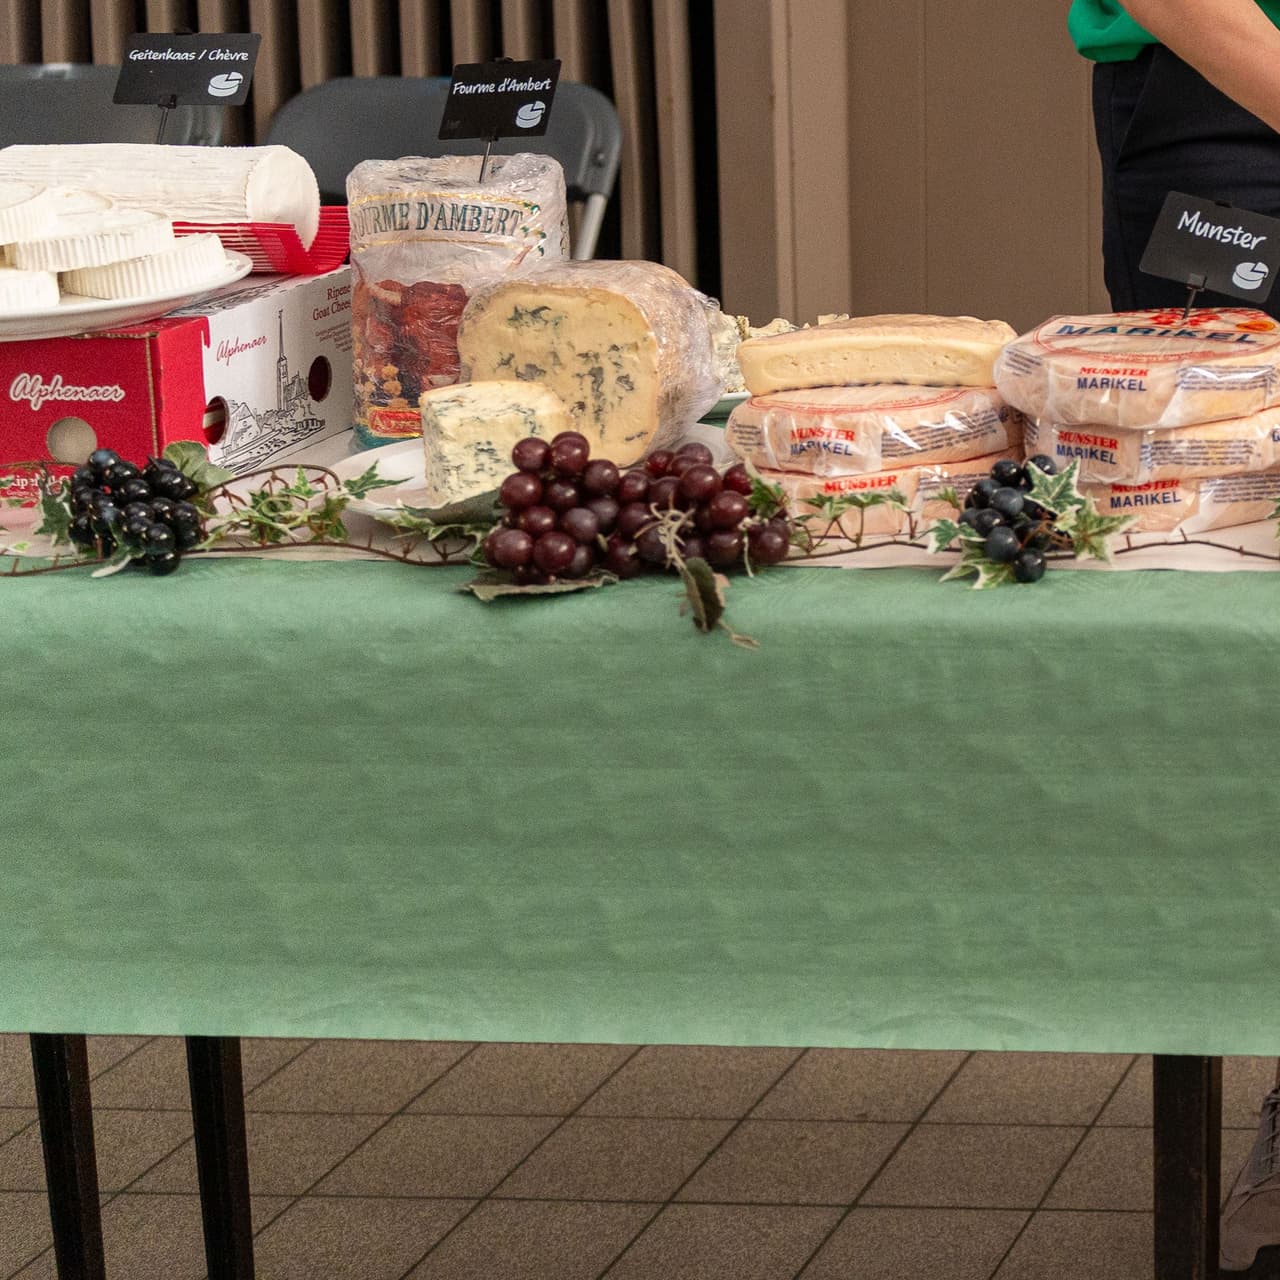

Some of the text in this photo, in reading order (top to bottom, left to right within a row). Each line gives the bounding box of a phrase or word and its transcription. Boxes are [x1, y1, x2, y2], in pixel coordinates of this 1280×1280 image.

[129, 48, 249, 61] Geitenkaas / Chèvre
[452, 77, 553, 95] Fourme d'Ambert
[415, 201, 524, 237] D'AMBERT
[1177, 210, 1268, 250] Munster
[327, 284, 351, 301] Ripene
[1056, 324, 1257, 343] MARIKEL
[216, 335, 268, 367] Alphenaer
[1080, 367, 1149, 377] MUNSTER
[9, 373, 125, 411] Alphenaer
[1077, 376, 1148, 392] MARIKEL
[790, 426, 855, 442] MUNSTER
[1057, 430, 1119, 450] MUNSTER
[1056, 444, 1118, 465] MARIKEL
[824, 475, 898, 494] MUNSTER
[1110, 479, 1180, 494] MUNSTER
[1109, 491, 1182, 509] MARIKEL
